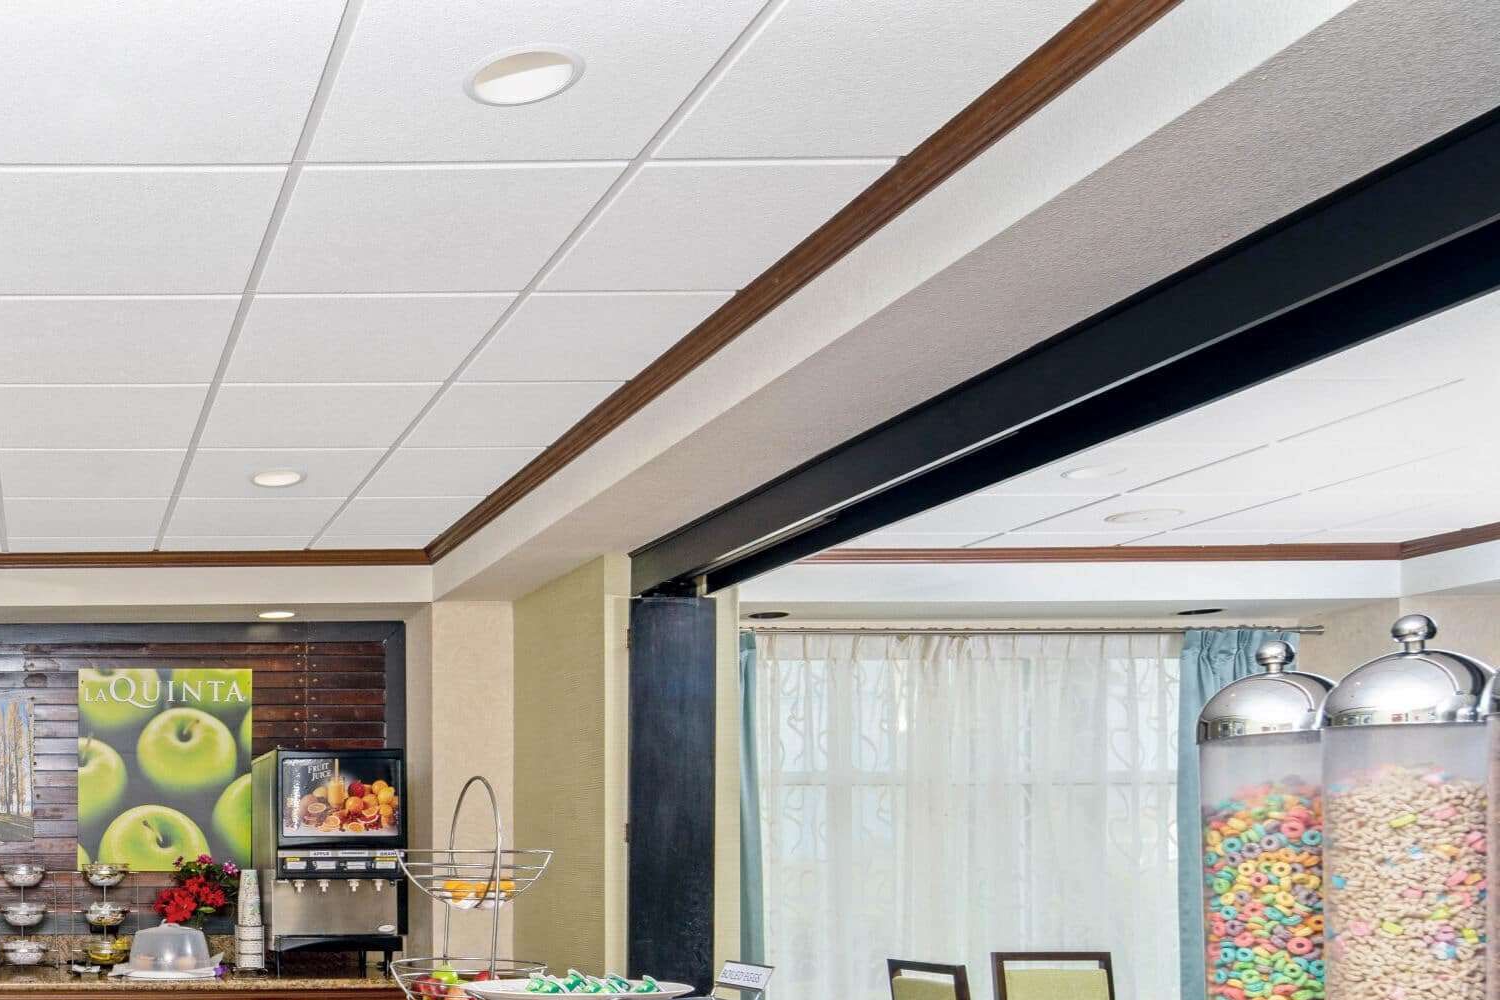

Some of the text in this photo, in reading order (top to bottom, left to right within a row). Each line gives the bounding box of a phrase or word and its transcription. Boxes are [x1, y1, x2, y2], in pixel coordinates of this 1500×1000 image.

[85, 677, 244, 708] LA QUINTA
[308, 763, 329, 774] FRUIT
[312, 770, 332, 781] JUICE
